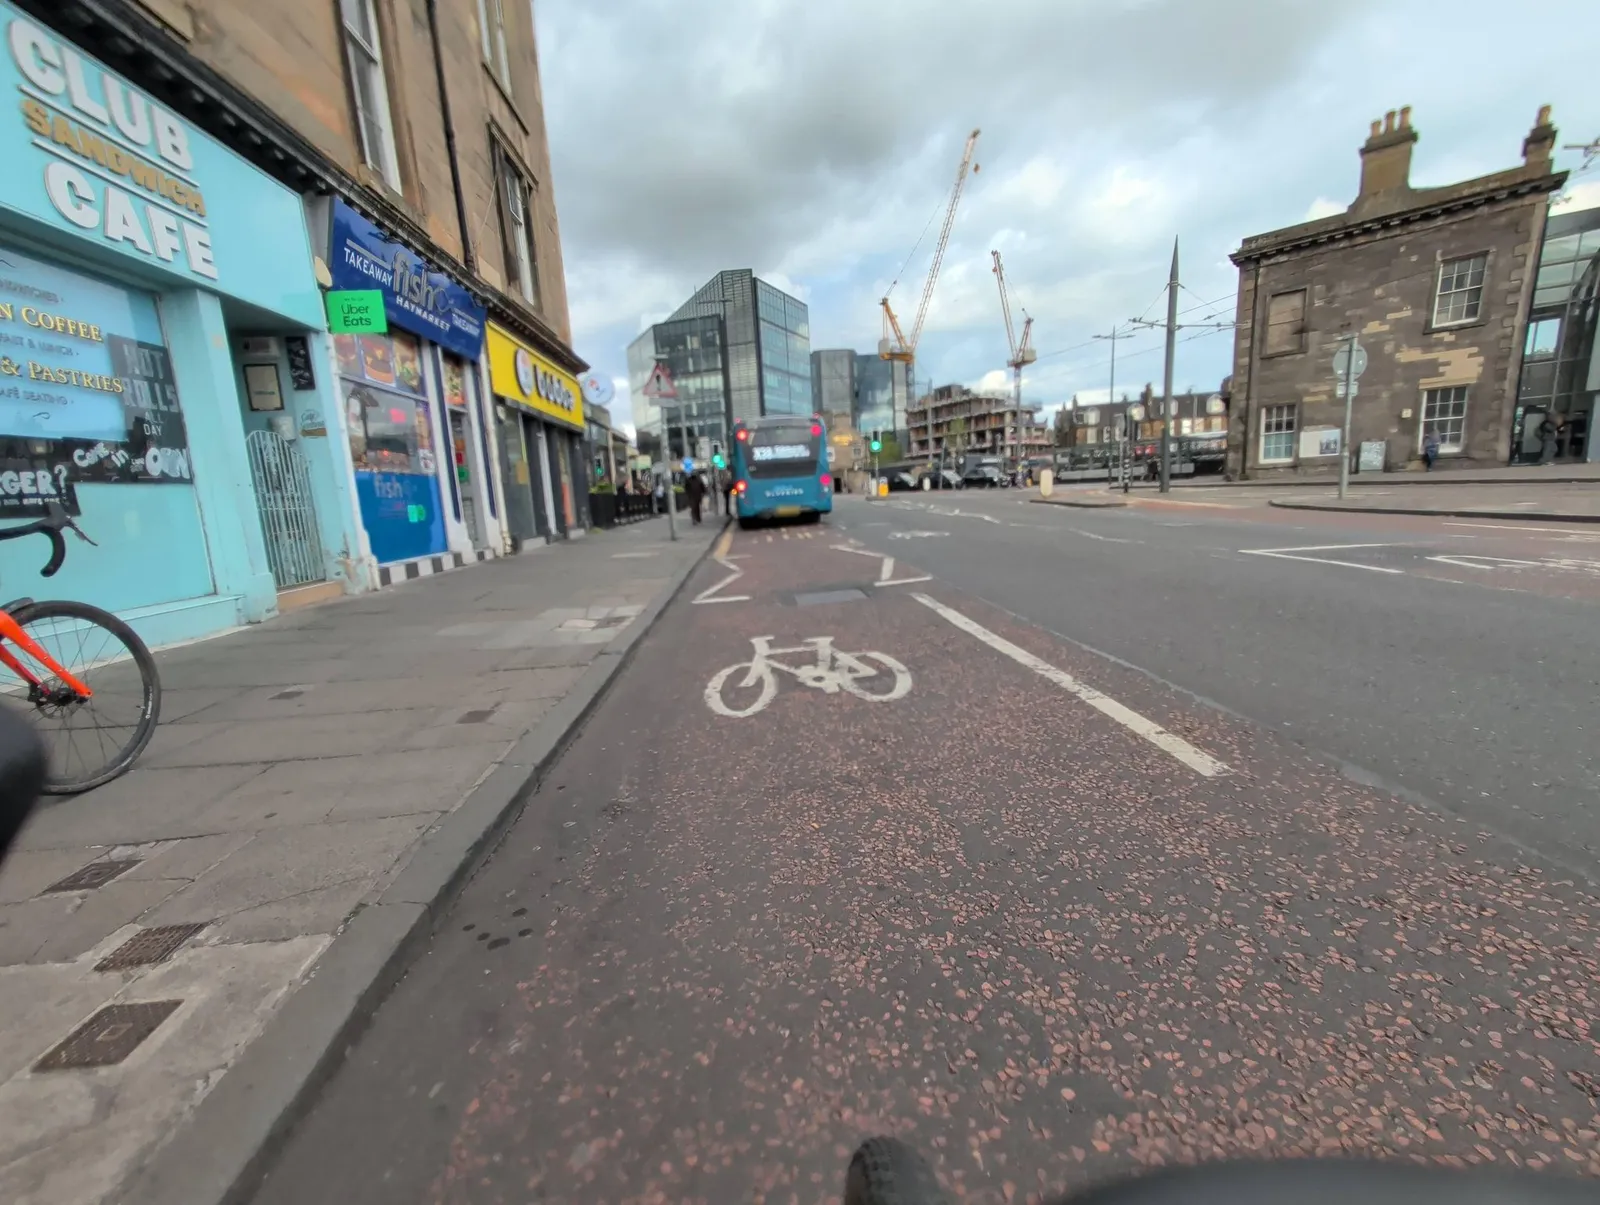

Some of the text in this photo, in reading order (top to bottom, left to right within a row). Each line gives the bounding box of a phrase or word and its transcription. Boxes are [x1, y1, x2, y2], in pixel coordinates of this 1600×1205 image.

[10, 18, 192, 170] CLUB
[20, 98, 206, 216] SANDWICH
[44, 161, 218, 280] CAFE
[344, 247, 392, 287] TAKEAWAY
[21, 307, 103, 342] COFFEE
[341, 303, 369, 315] Uber
[343, 316, 372, 327] Eats
[396, 295, 450, 332] HAYMARKET
[28, 360, 124, 393] PASTRIES
[122, 344, 165, 380] HOT
[122, 378, 180, 413] ROLLS
[143, 423, 162, 436] DAY
[144, 411, 164, 424] ALL
